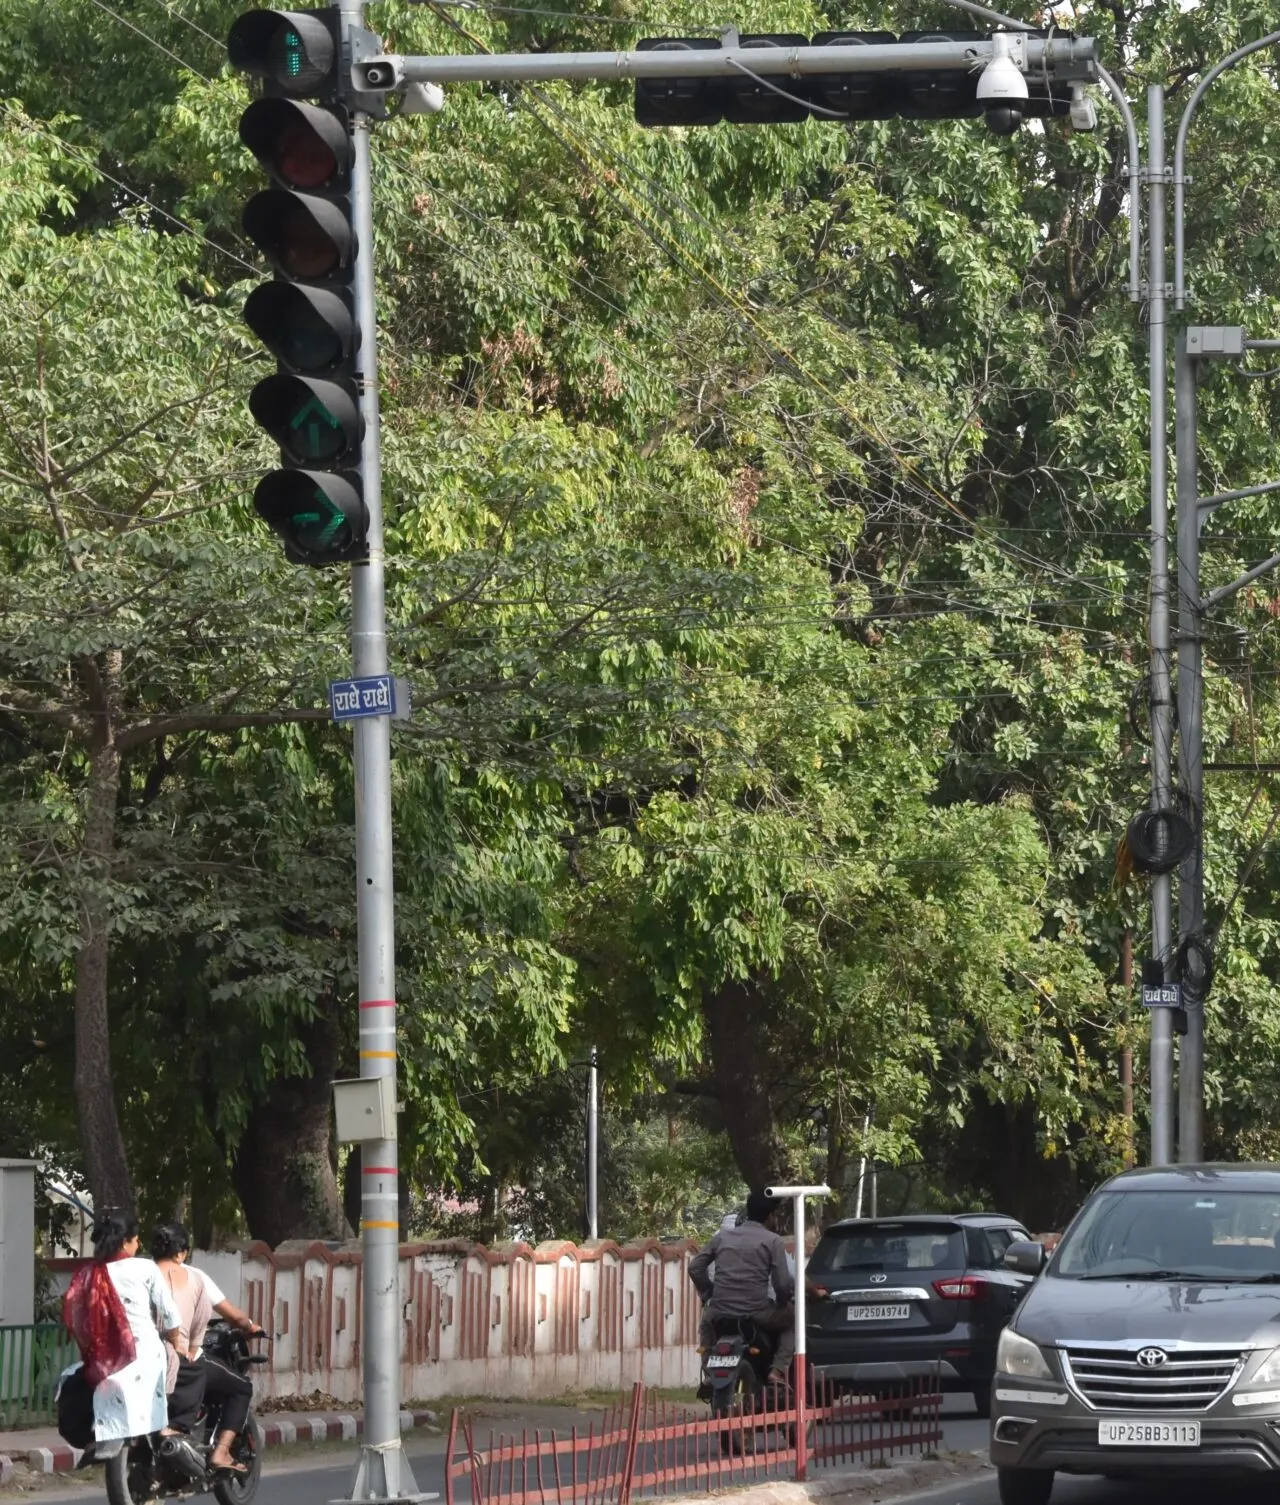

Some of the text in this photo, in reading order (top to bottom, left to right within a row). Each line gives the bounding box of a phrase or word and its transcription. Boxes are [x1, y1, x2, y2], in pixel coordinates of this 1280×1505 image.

[335, 681, 388, 711] राधे राधे
[1162, 987, 1177, 1002] राधे
[1110, 1426, 1196, 1441] UP25BB3113
